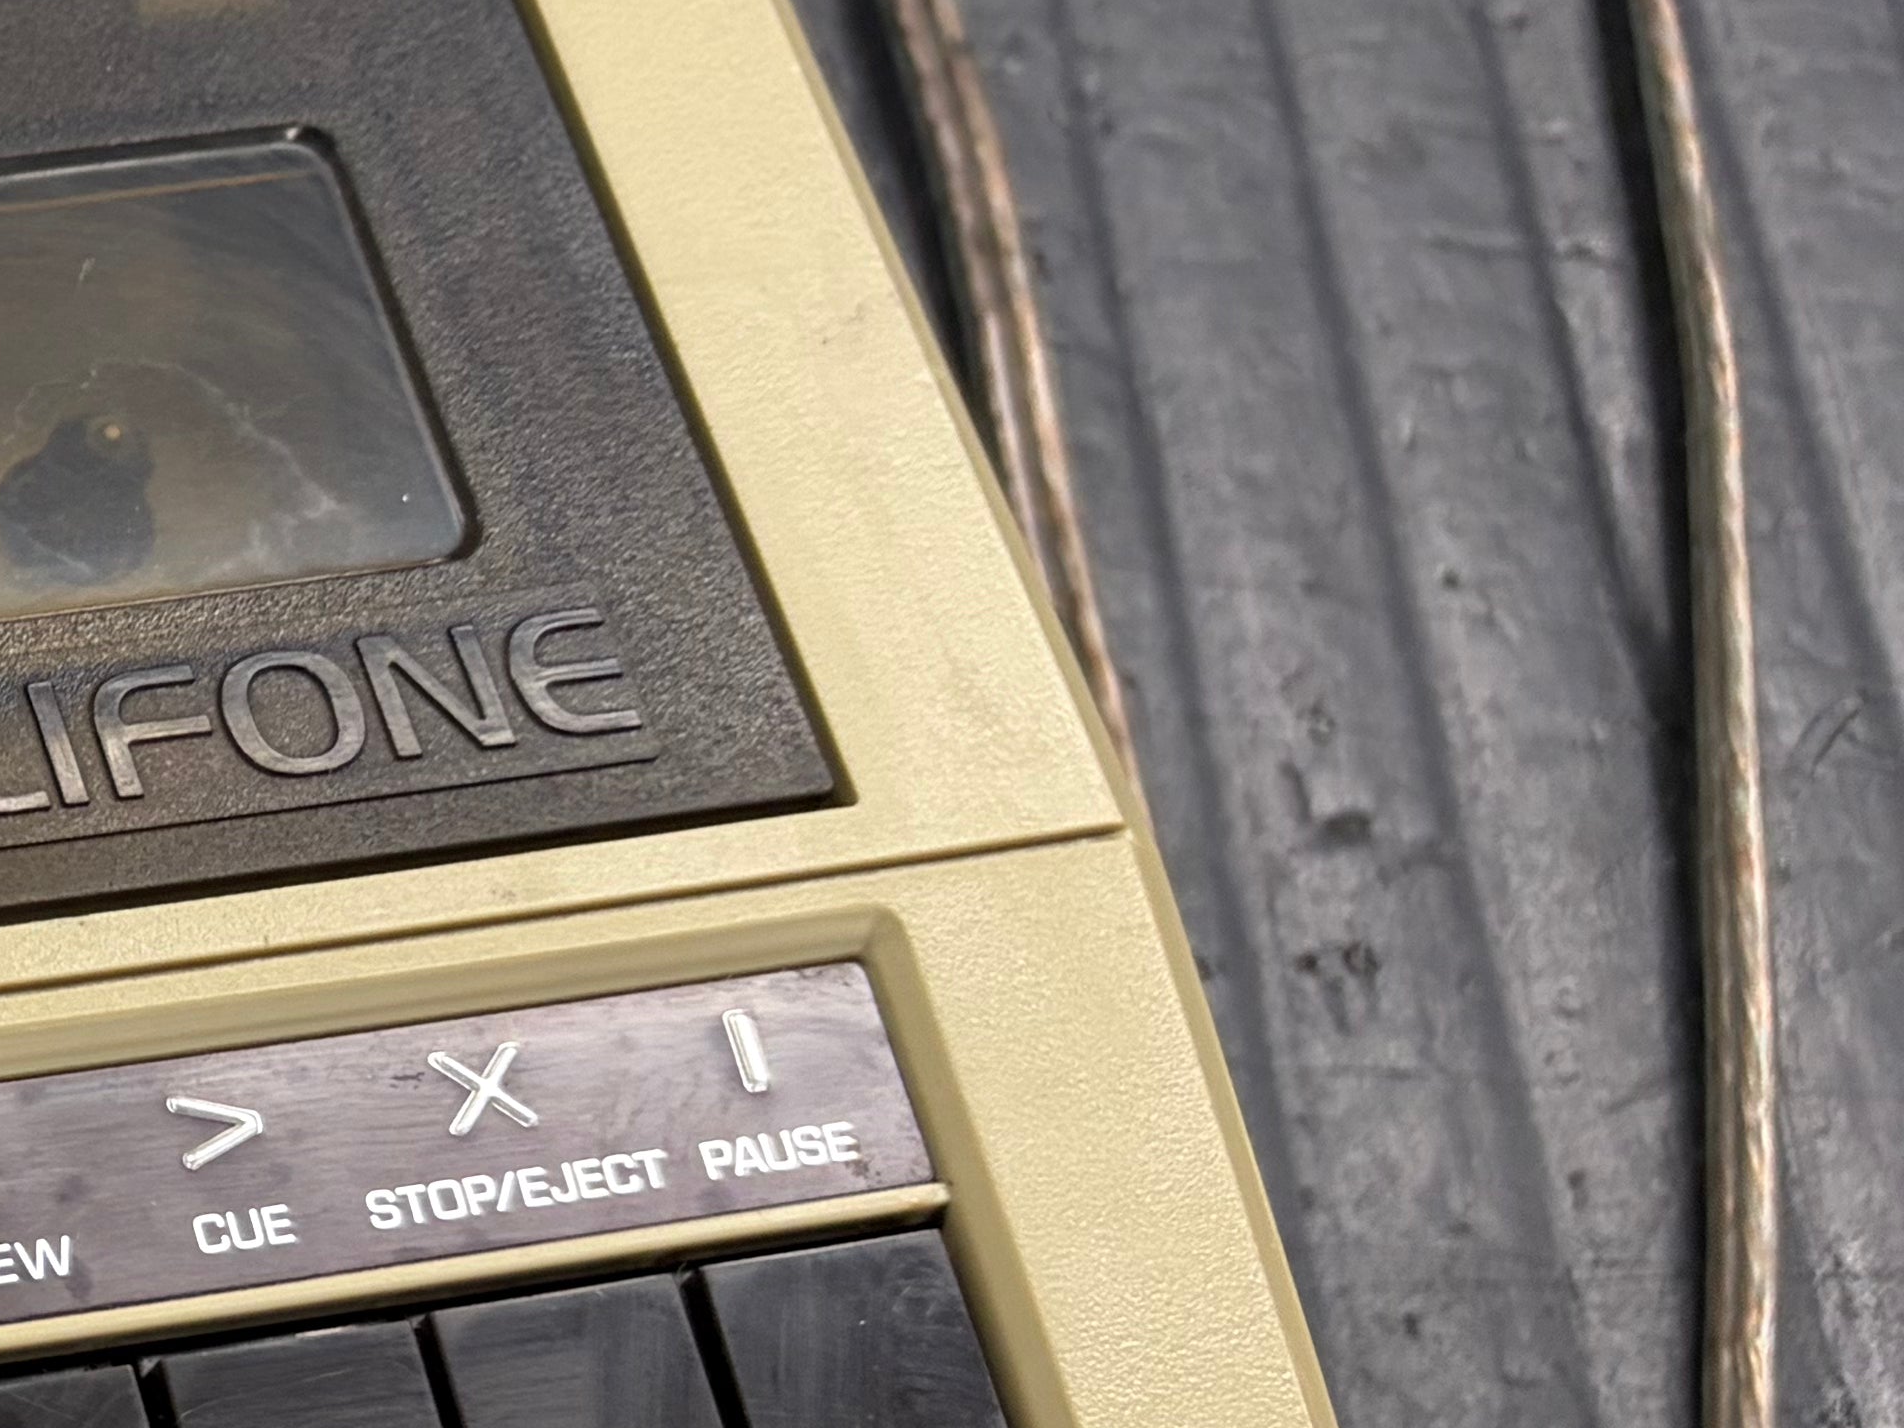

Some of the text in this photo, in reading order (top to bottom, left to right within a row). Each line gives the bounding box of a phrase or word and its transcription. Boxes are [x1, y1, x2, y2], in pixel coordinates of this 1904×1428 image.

[699, 1121, 859, 1179] PAUSE
[365, 1149, 668, 1230] STOP/EJECT
[192, 1203, 298, 1255] CUE
